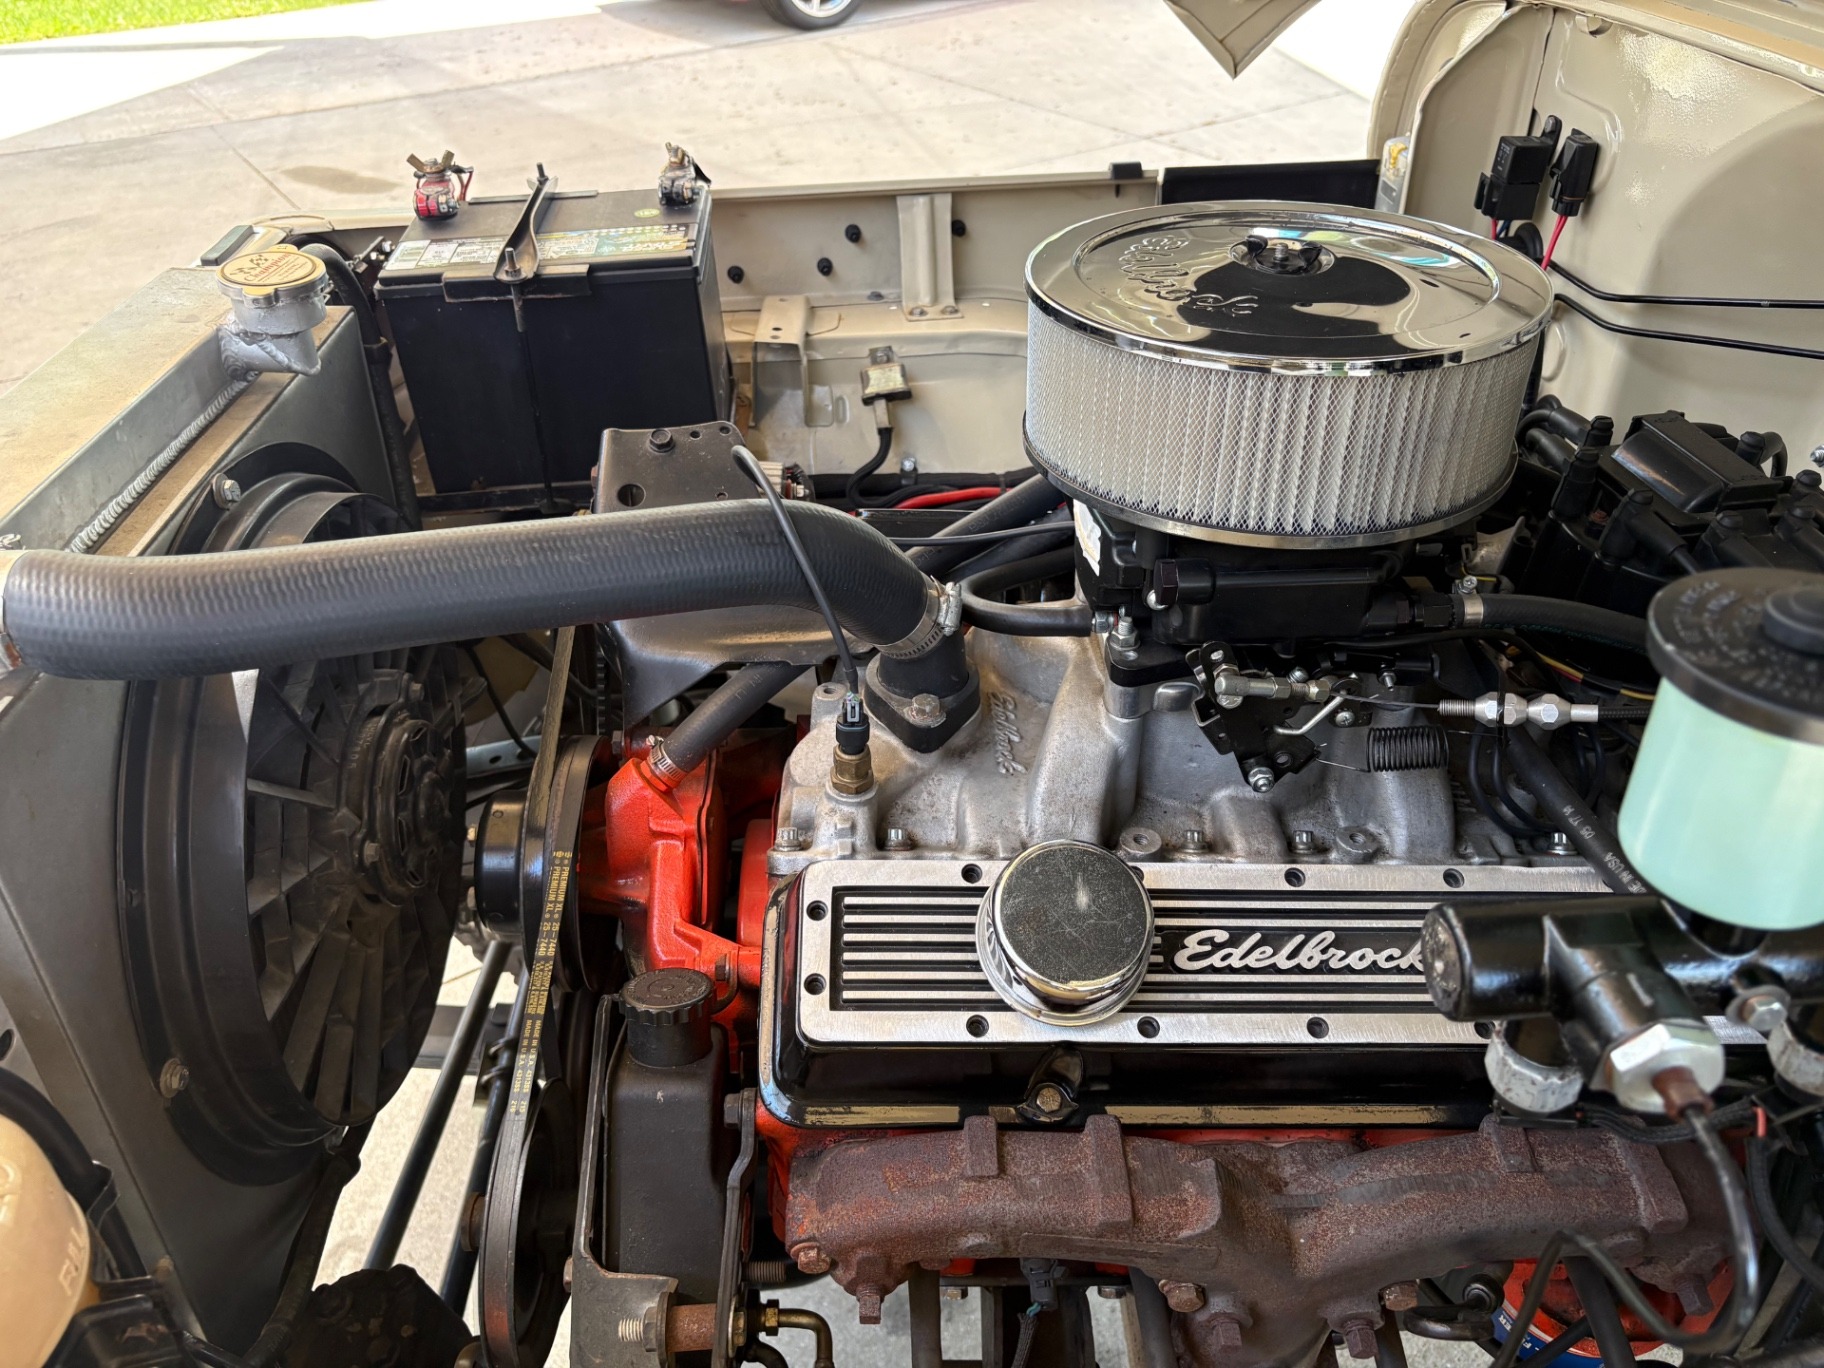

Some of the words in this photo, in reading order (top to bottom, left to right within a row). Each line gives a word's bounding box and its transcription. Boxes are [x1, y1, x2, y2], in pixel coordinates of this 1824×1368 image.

[1604, 852, 1624, 873] USA
[548, 867, 561, 901] PREMIUM
[557, 867, 569, 901] PREMIUM
[1174, 929, 1424, 971] Edelbrock
[524, 1019, 532, 1037] MADE
[533, 1019, 541, 1037] MADE
